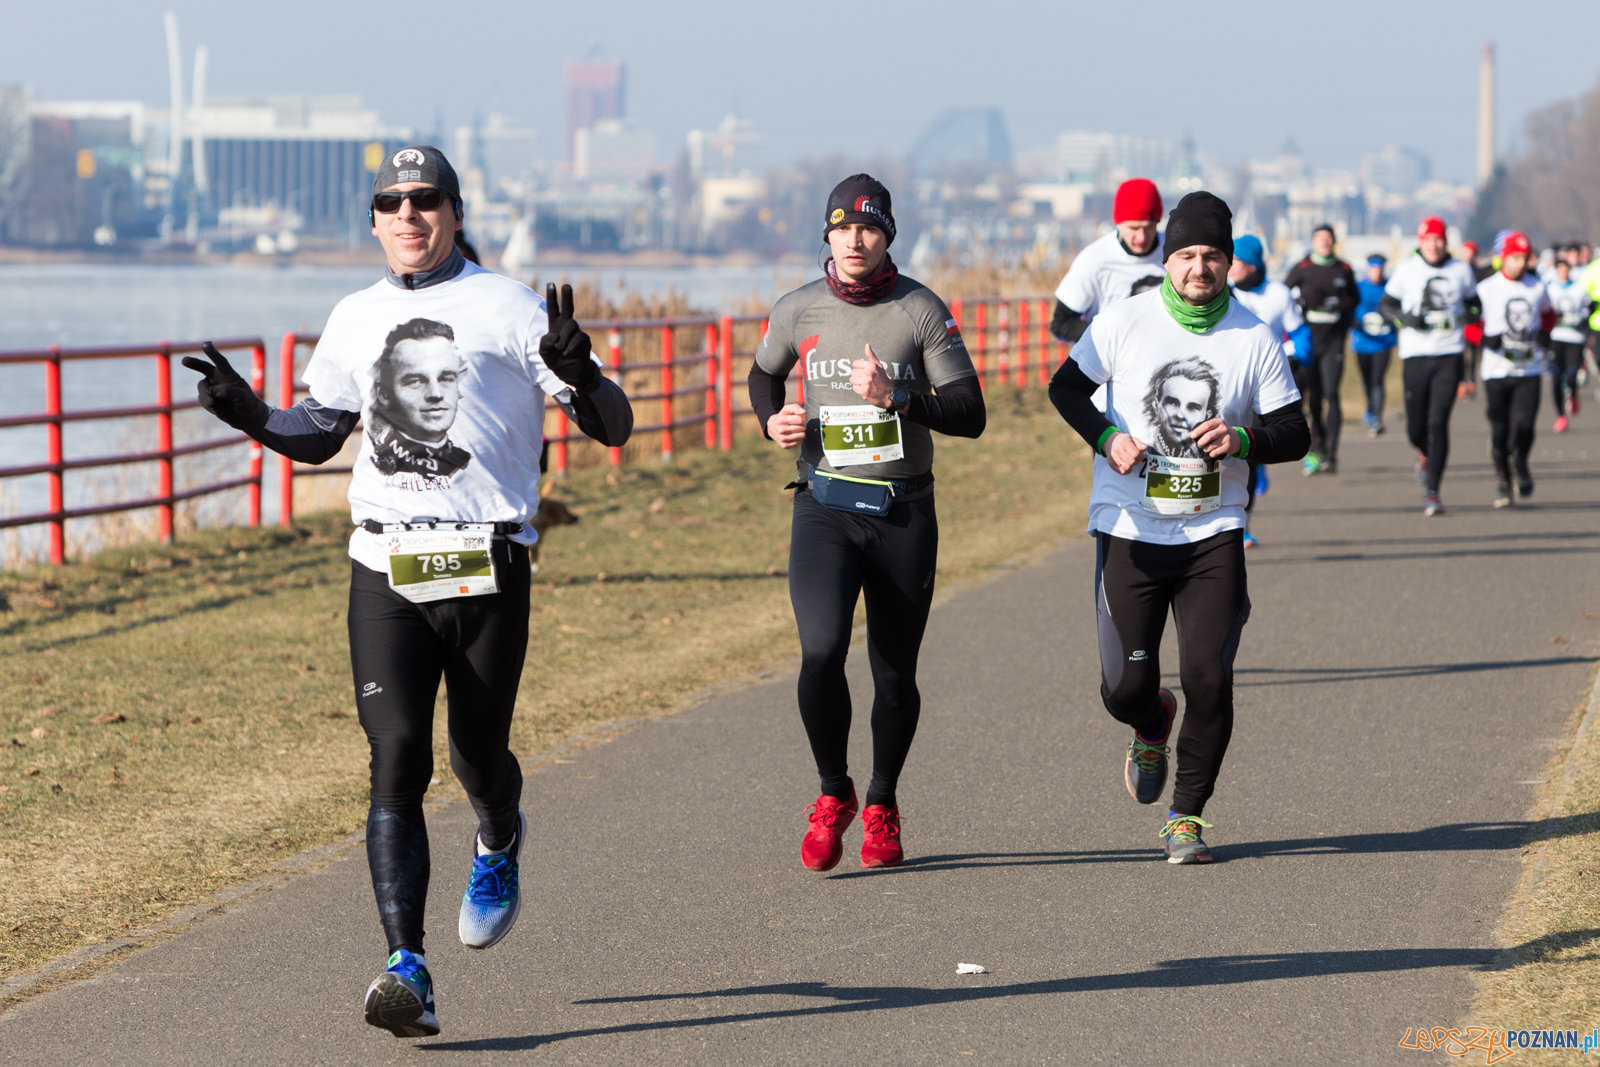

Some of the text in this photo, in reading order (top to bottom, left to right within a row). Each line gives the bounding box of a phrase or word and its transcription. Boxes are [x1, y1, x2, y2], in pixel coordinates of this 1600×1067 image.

[806, 349, 916, 381] HUSRIA
[831, 381, 853, 391] RAC
[842, 424, 874, 443] 311
[1169, 476, 1203, 493] 325
[416, 554, 462, 573] 795
